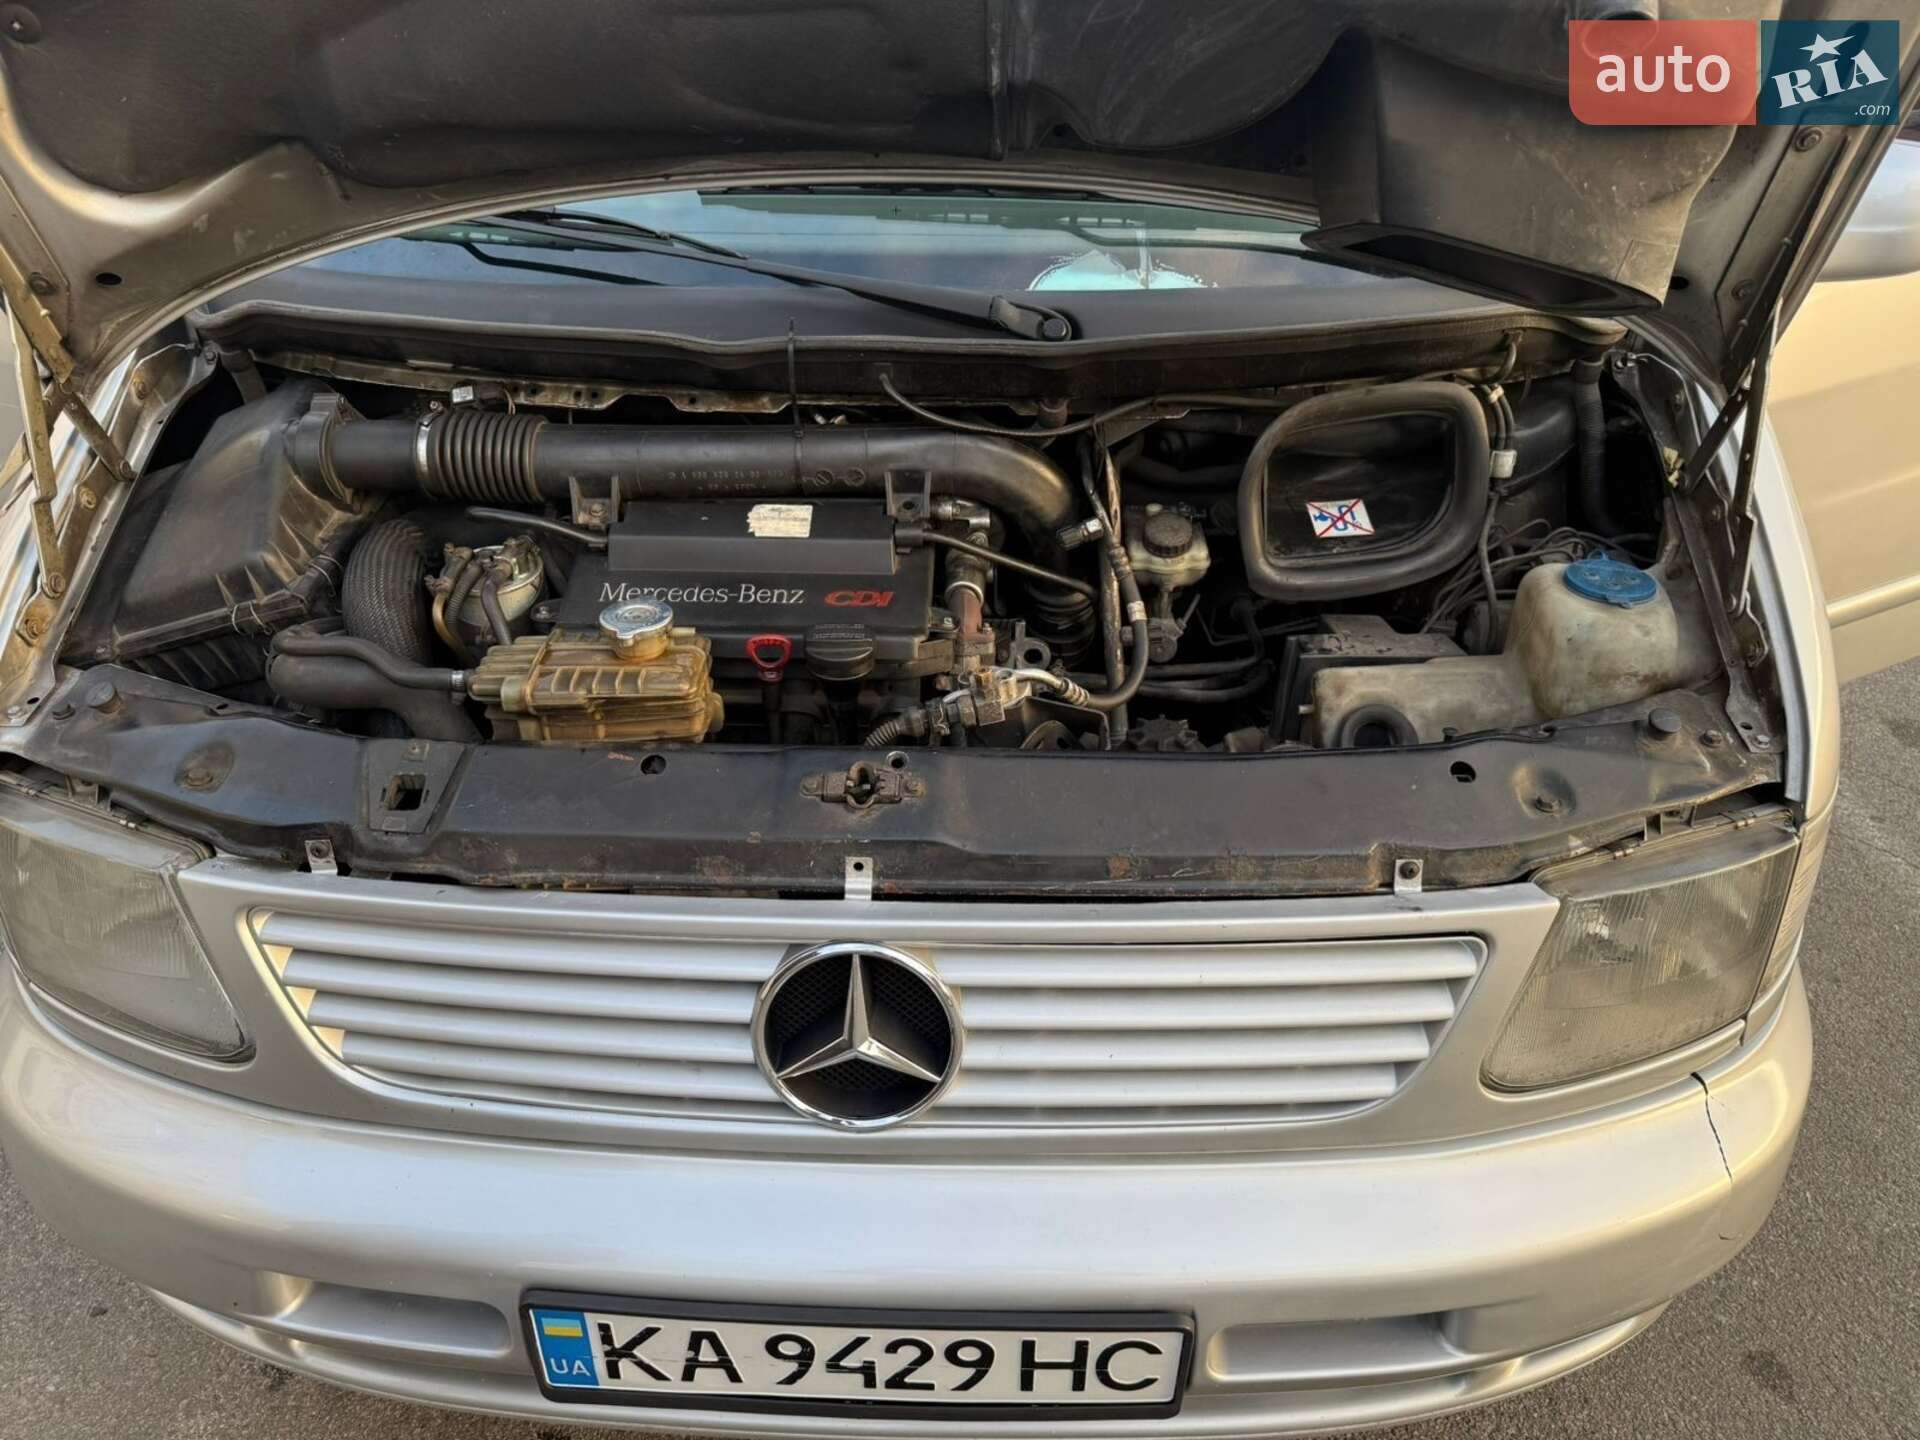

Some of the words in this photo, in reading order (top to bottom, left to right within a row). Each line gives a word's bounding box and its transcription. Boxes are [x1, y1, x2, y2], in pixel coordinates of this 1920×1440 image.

[600, 583, 804, 604] Mercedes-Benz
[550, 1357, 591, 1376] UA
[597, 1322, 743, 1384] KA
[763, 1333, 996, 1391] 9429
[1018, 1339, 1164, 1393] HC
